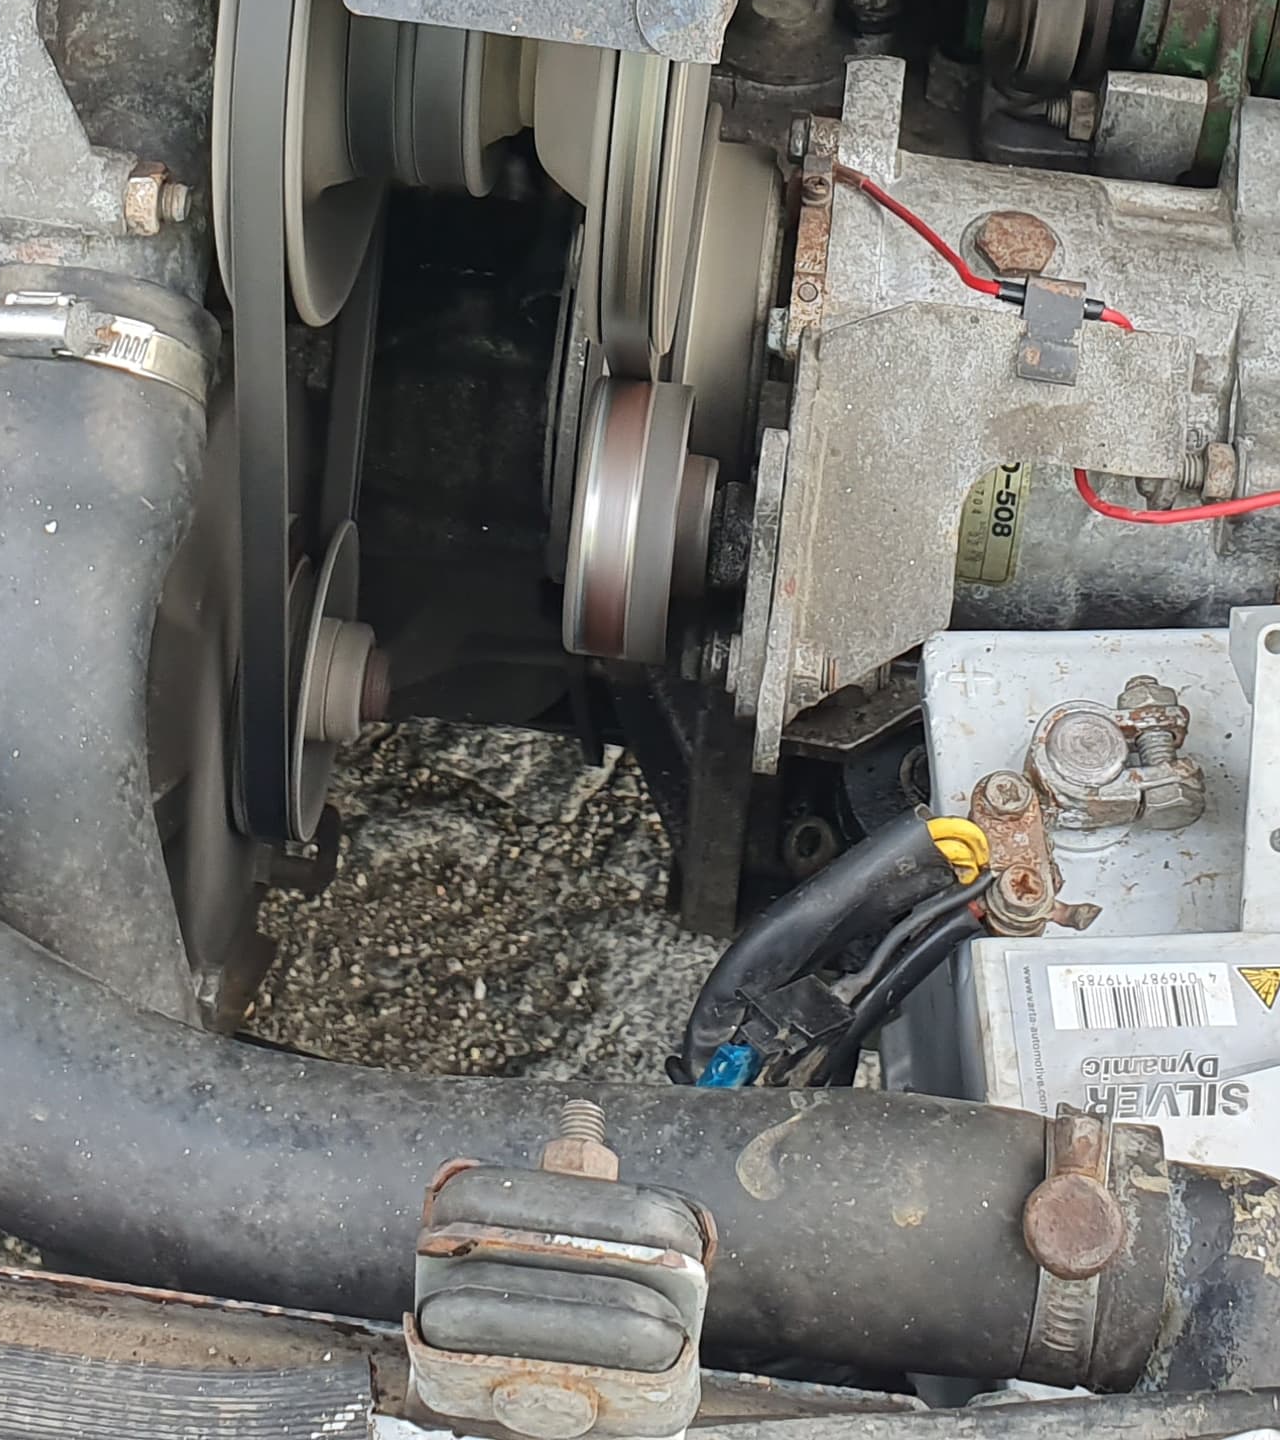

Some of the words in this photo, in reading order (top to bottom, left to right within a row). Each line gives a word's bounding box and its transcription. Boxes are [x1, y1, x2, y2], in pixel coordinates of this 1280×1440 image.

[1077, 973, 1131, 987] 119785
[1140, 971, 1197, 985] 016987
[1023, 965, 1049, 1113] www.varta-automotive.com
[1081, 1048, 1220, 1081] Dynamic
[1083, 1081, 1250, 1119] SILVER
